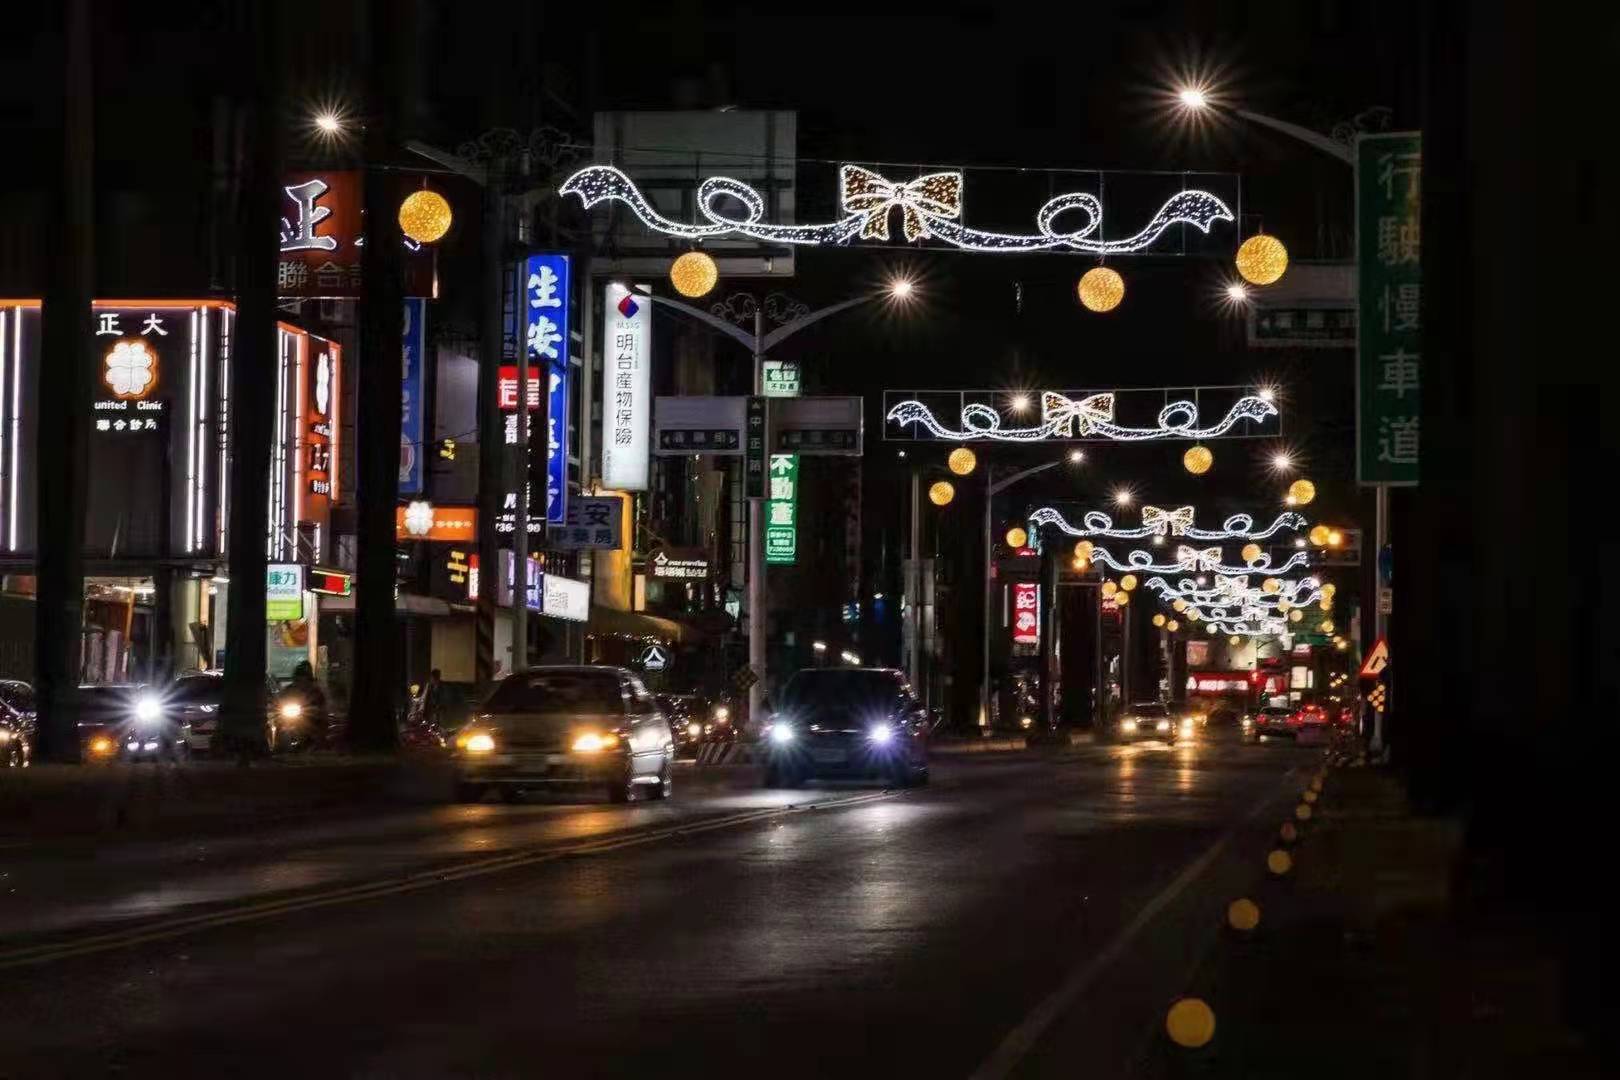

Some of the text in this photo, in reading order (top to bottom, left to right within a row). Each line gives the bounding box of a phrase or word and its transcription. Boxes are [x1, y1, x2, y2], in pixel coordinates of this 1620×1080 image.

[1376, 150, 1422, 464] 行駛慢車道
[95, 313, 169, 336] 正大
[94, 400, 163, 410] united Clinic
